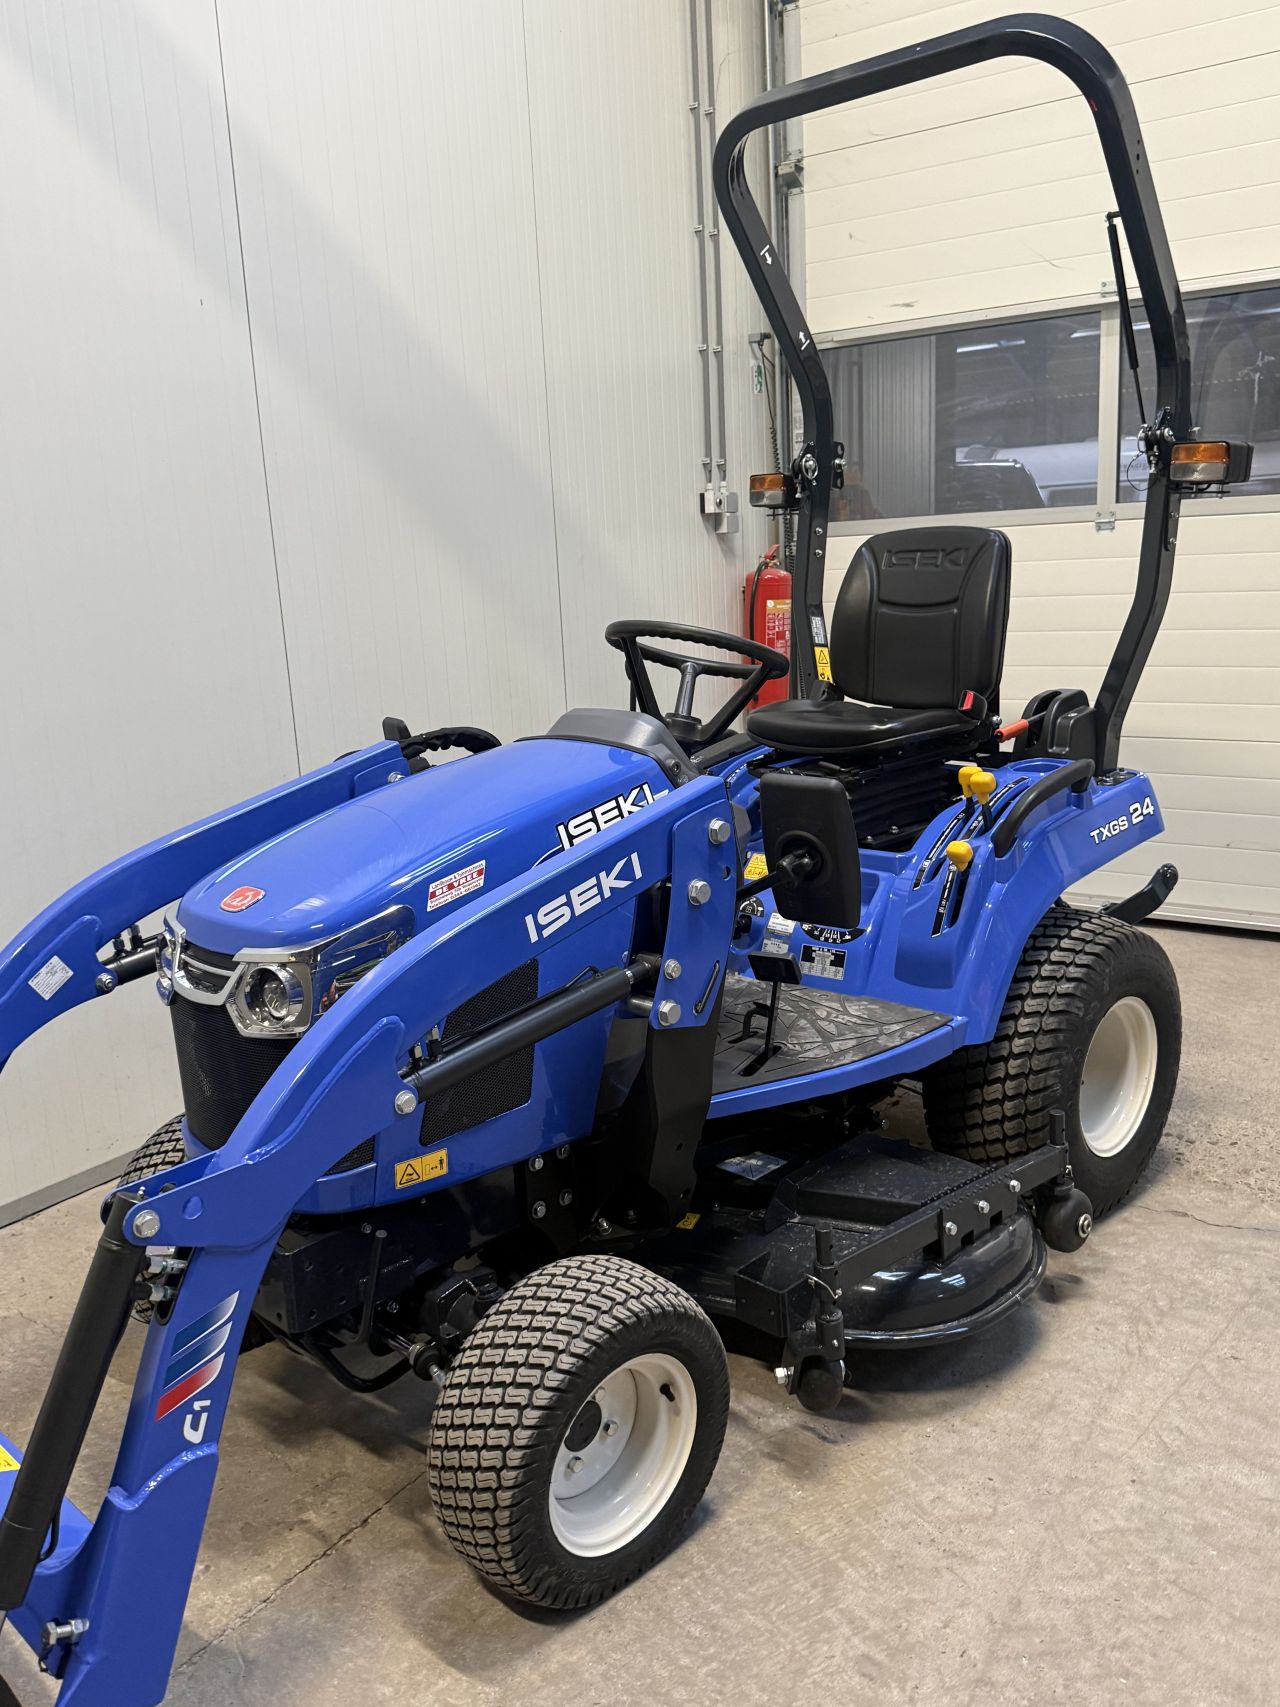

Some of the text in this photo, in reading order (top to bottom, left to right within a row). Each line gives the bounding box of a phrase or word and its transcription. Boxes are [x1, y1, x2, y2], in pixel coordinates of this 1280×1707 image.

[881, 547, 969, 570] ISEKI
[556, 782, 655, 852] ISEKI
[1089, 796, 1155, 844] TXGS 24
[435, 885, 449, 896] DE
[453, 872, 479, 888] VREE
[524, 852, 643, 944] ISEKI
[183, 1399, 212, 1445] C1
